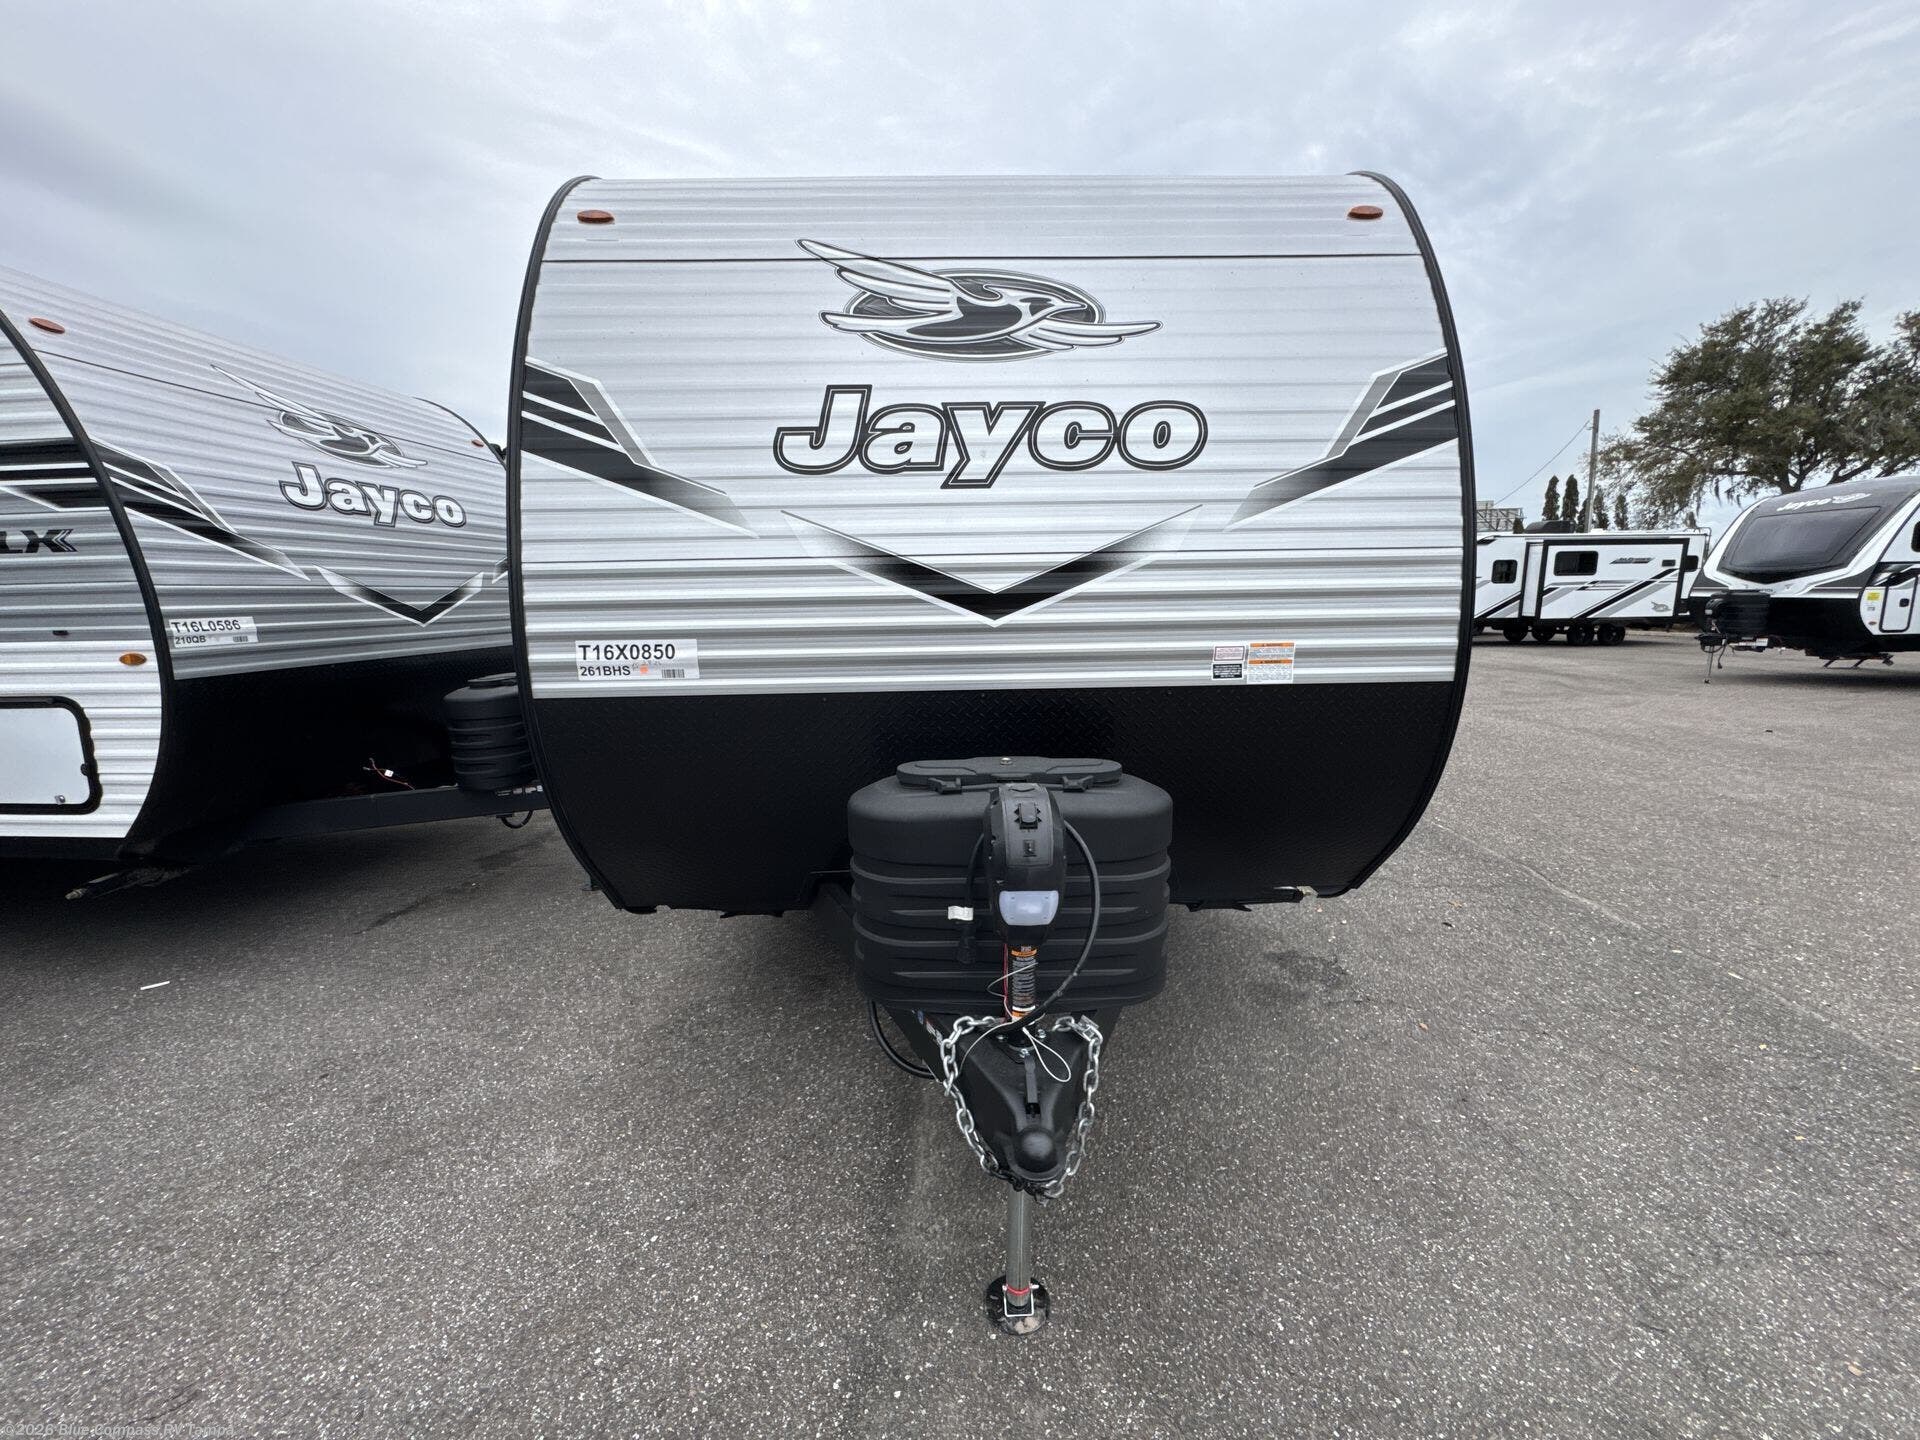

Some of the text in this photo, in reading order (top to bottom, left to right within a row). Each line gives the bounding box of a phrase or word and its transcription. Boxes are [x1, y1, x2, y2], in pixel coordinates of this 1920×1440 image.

[773, 384, 1208, 489] Jayco
[278, 461, 467, 528] Jayco
[171, 619, 241, 633] T16L0586
[175, 635, 207, 644] 210QB
[578, 643, 676, 660] T16X0850
[580, 665, 631, 676] 261BHS
